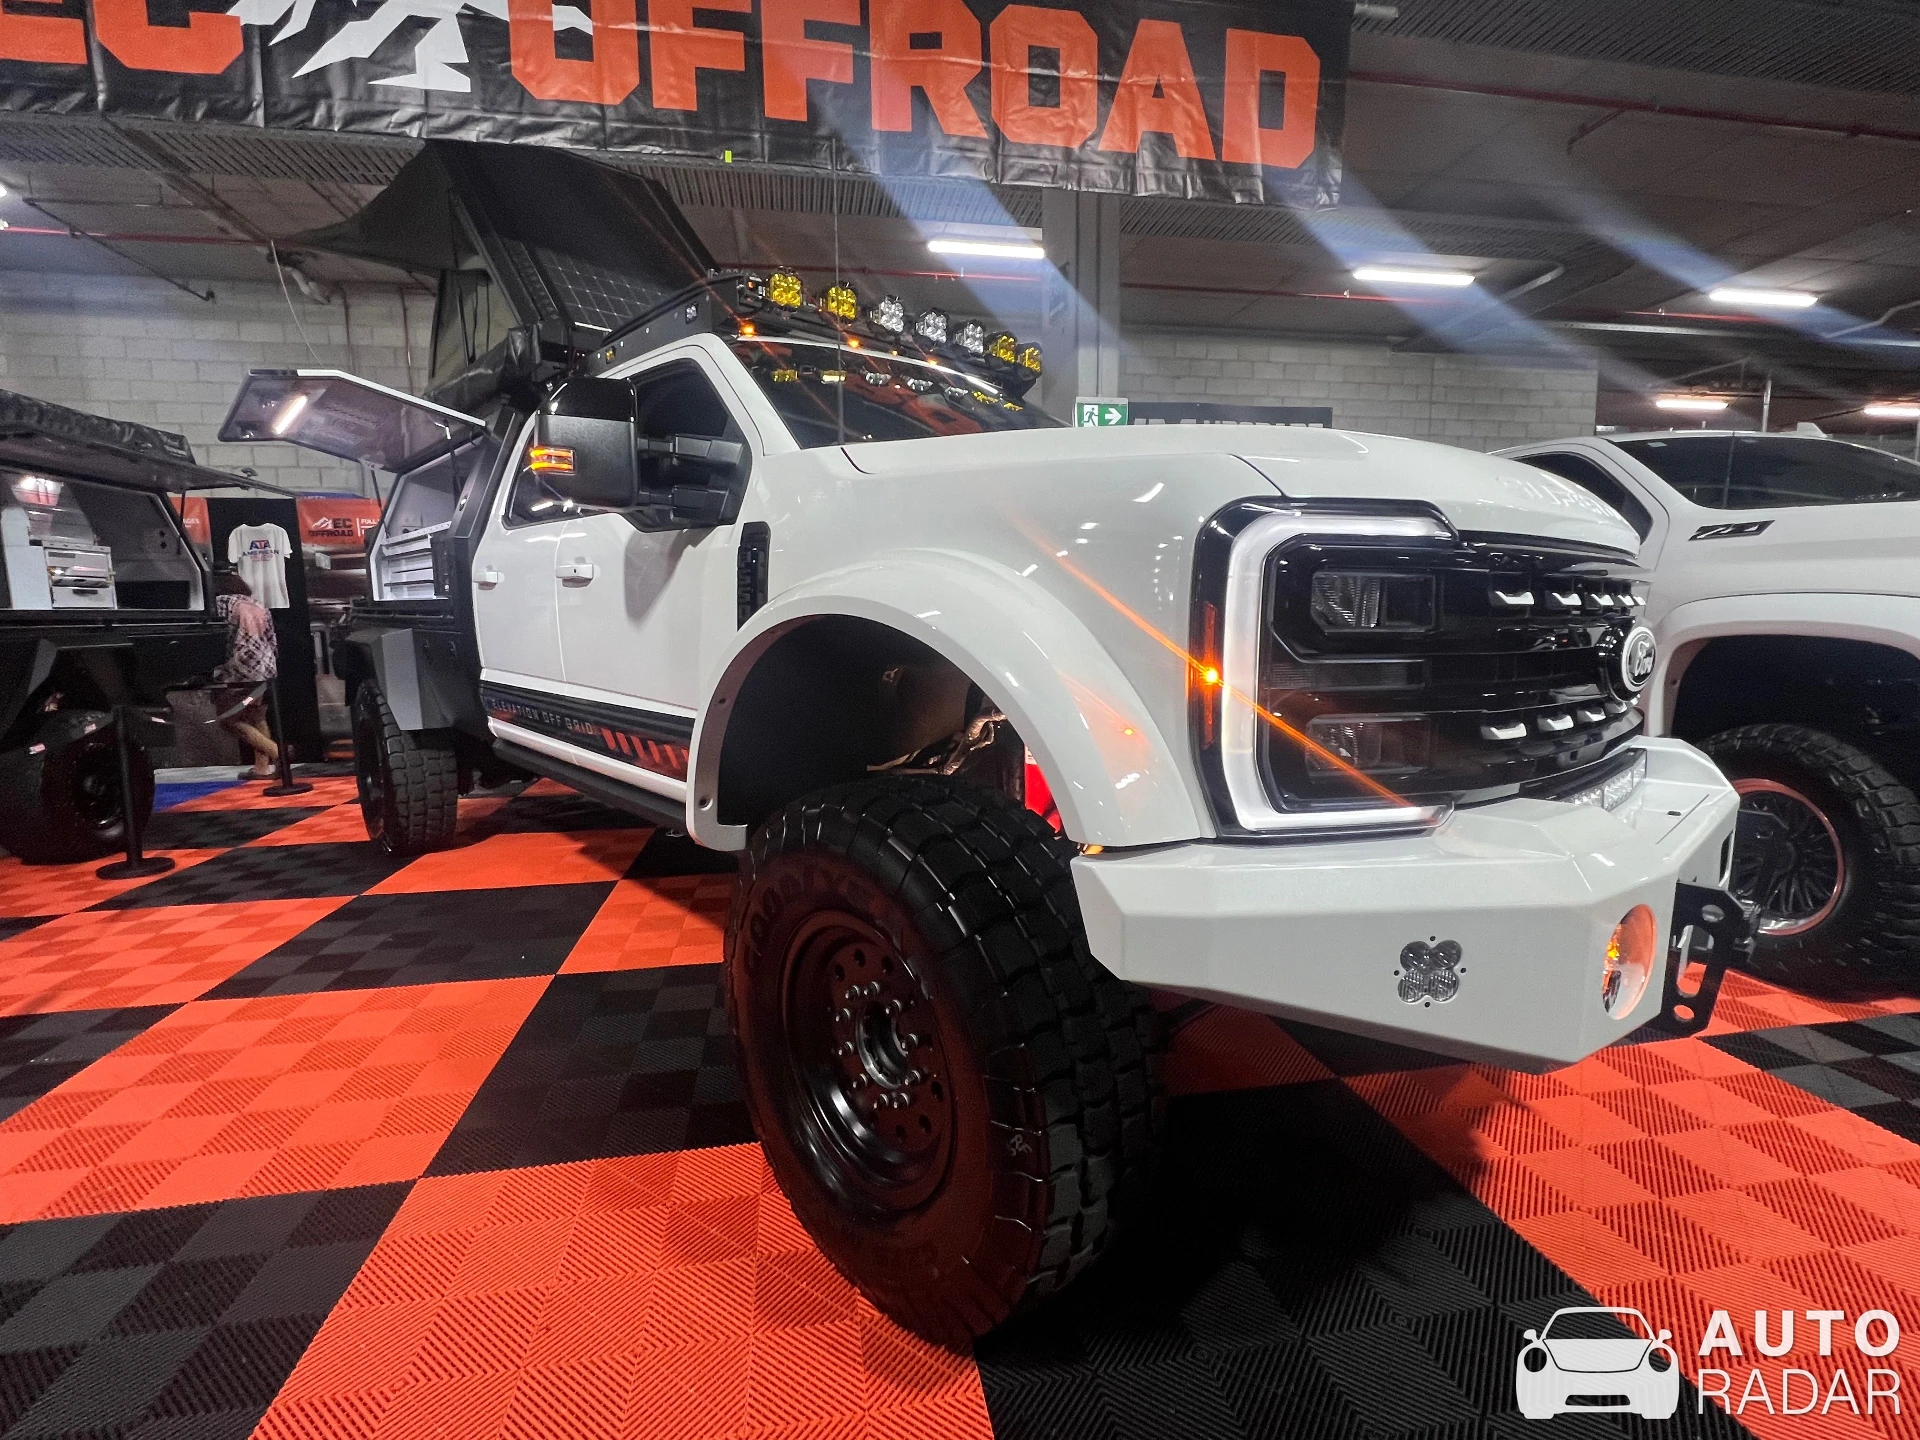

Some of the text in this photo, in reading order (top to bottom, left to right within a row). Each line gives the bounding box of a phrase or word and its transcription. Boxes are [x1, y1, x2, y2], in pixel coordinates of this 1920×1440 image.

[332, 518, 354, 529] EC
[308, 529, 354, 537] OFFROAD
[491, 699, 594, 735] ELEVATION OFF GRID
